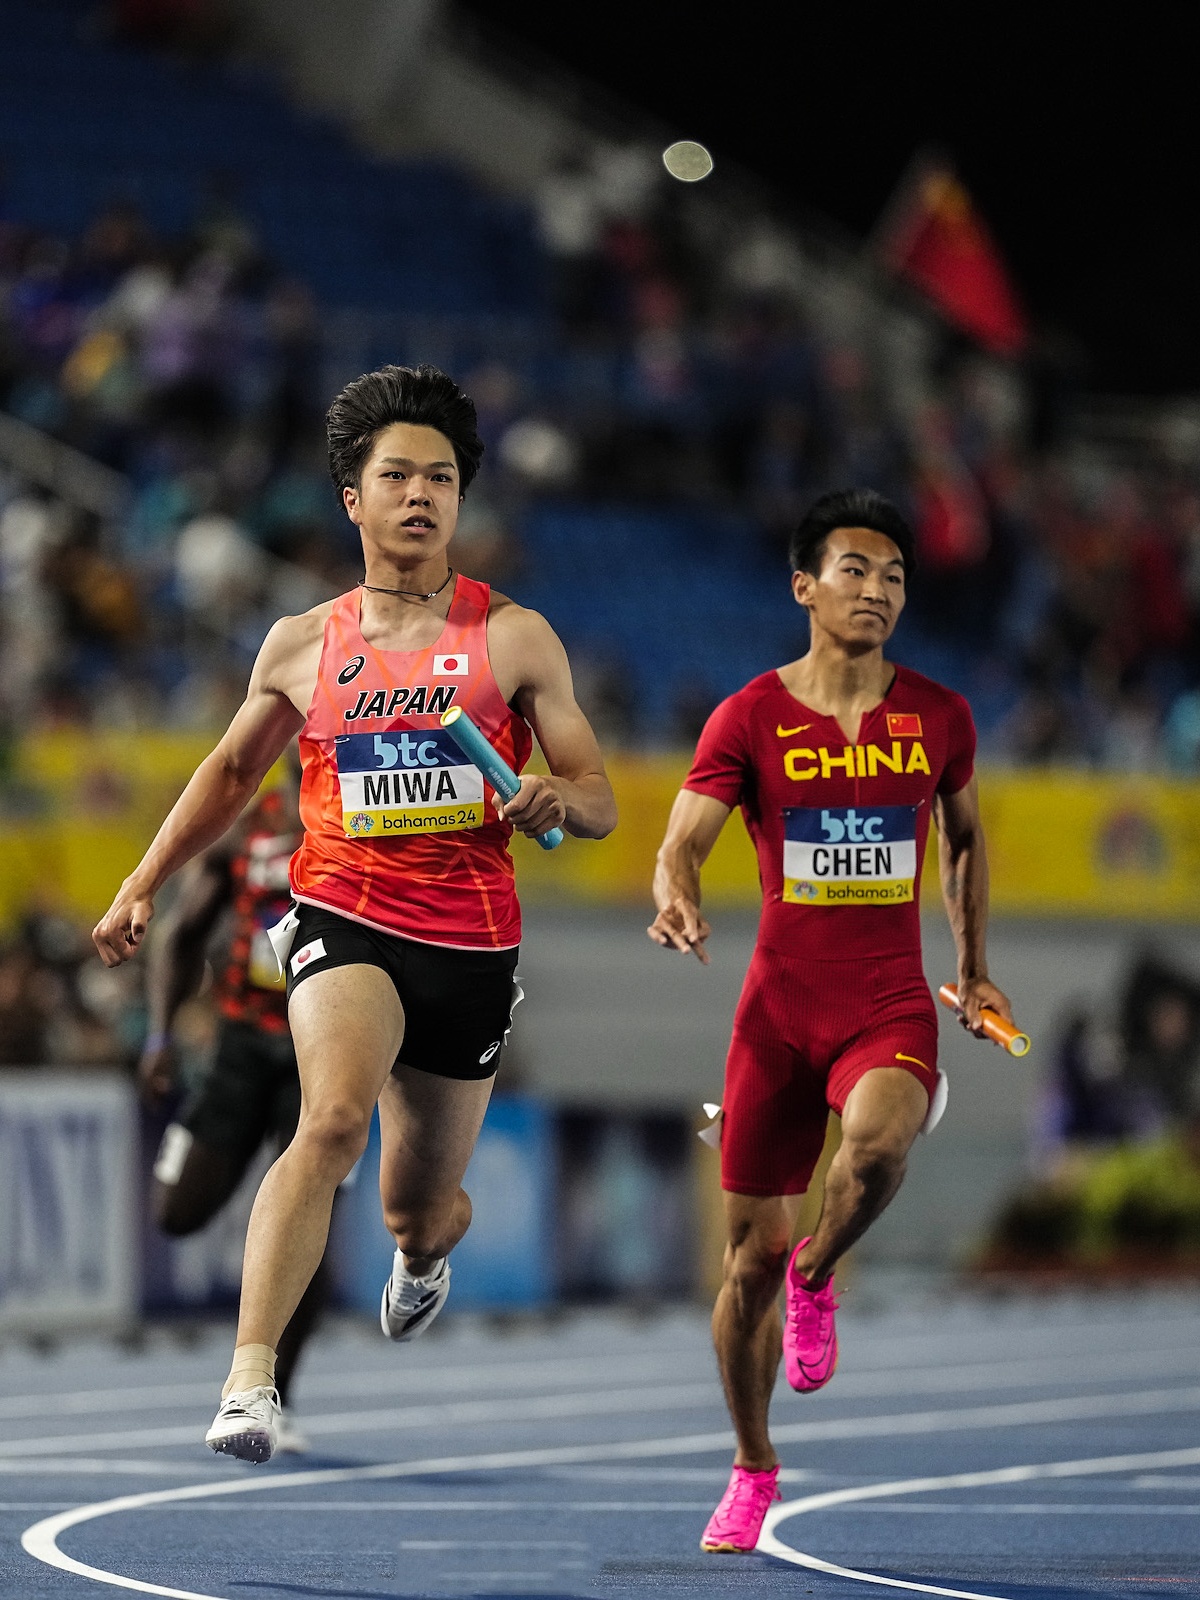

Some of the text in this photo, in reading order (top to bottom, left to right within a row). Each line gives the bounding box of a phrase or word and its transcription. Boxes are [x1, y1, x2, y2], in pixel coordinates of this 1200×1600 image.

[344, 686, 458, 722] JAPAN
[373, 733, 440, 769] btc
[783, 741, 931, 781] CHINA
[363, 770, 458, 806] MIWA
[820, 809, 884, 843] btc
[812, 846, 892, 876] CHEN
